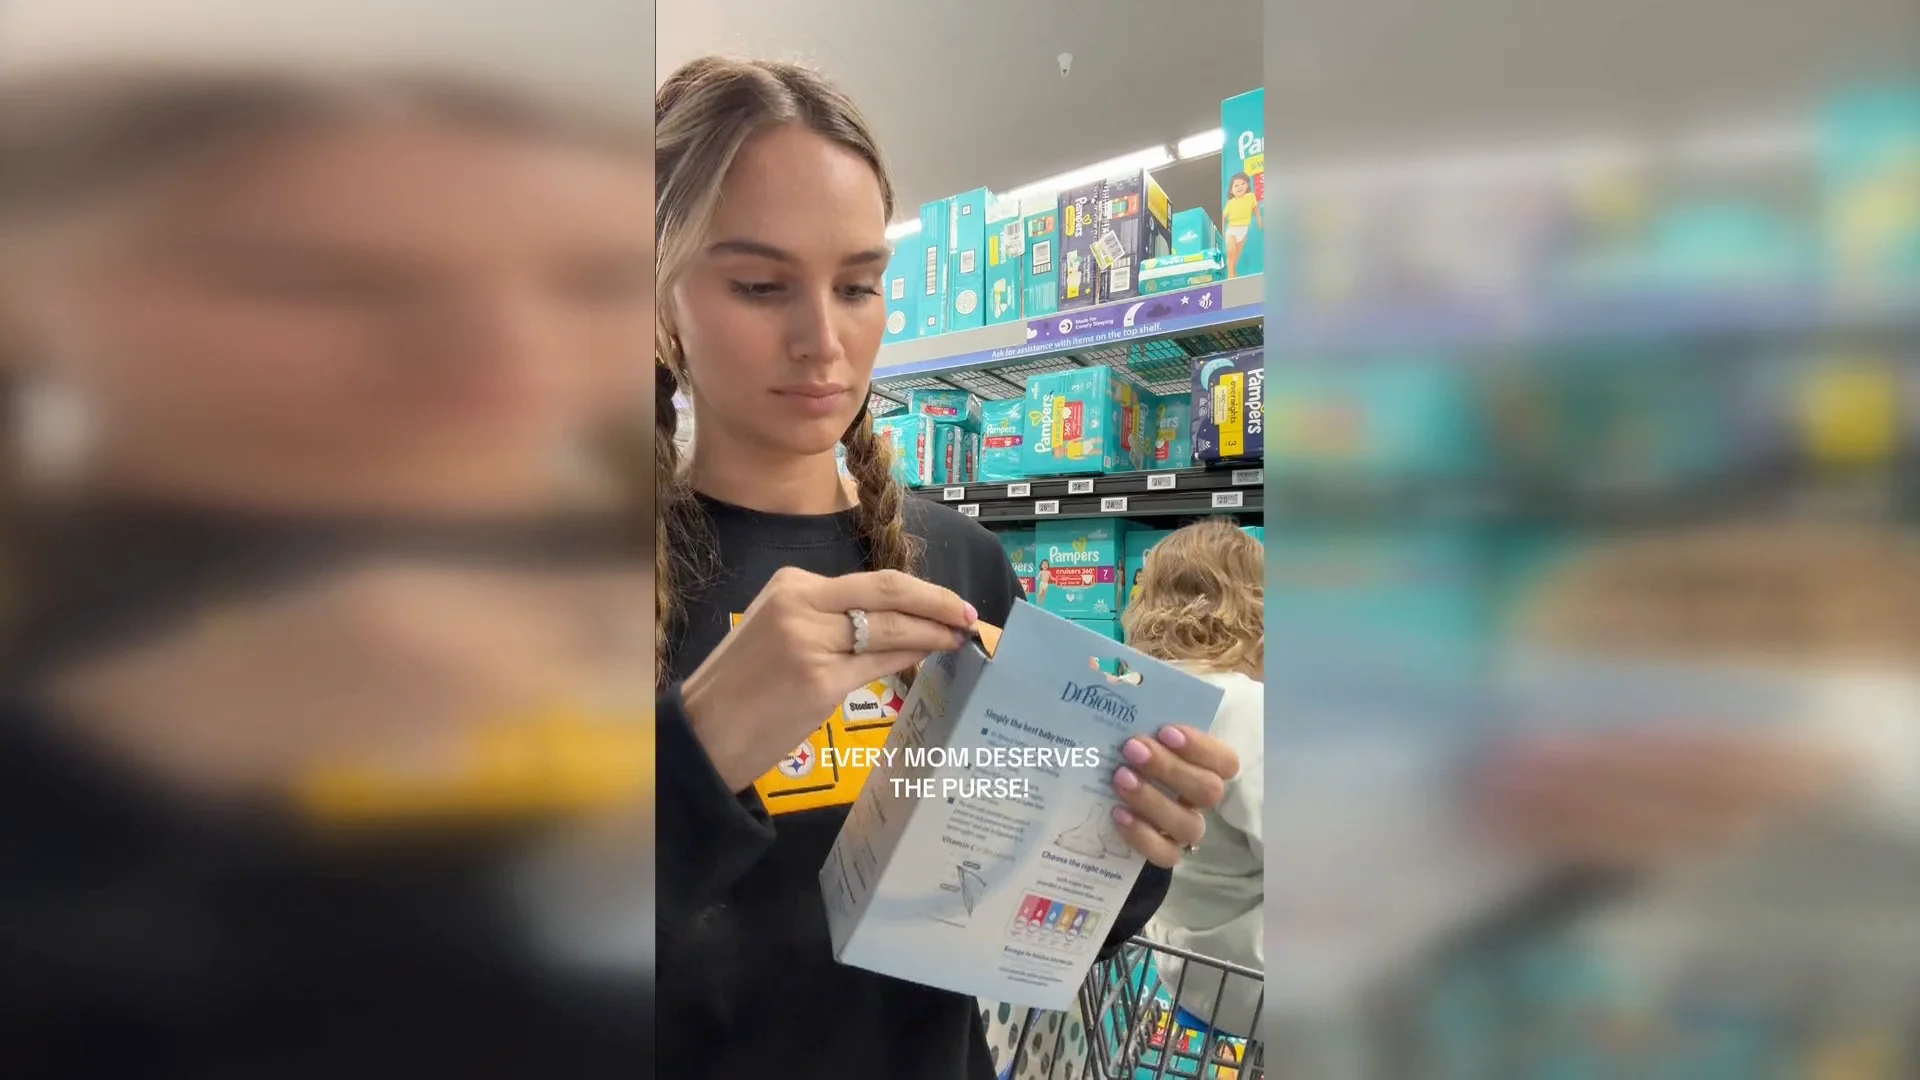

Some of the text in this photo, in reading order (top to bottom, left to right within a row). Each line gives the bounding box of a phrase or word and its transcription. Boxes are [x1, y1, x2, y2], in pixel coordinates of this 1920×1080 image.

[991, 321, 1162, 358] Ask for assistance with items on the top shelf.
[1228, 380, 1238, 424] overnights
[986, 423, 1017, 435] Pampers
[1034, 394, 1055, 453] Pampers
[1049, 545, 1100, 565] Pampers
[1103, 569, 1109, 577] 7
[849, 701, 879, 711] Steelers
[985, 708, 1010, 726] Simply
[1010, 718, 1023, 729] the
[1038, 728, 1056, 744] baby
[942, 834, 970, 849] Vitamin
[1041, 850, 1068, 864] Choose
[1068, 858, 1081, 868] the
[1081, 863, 1099, 873] right
